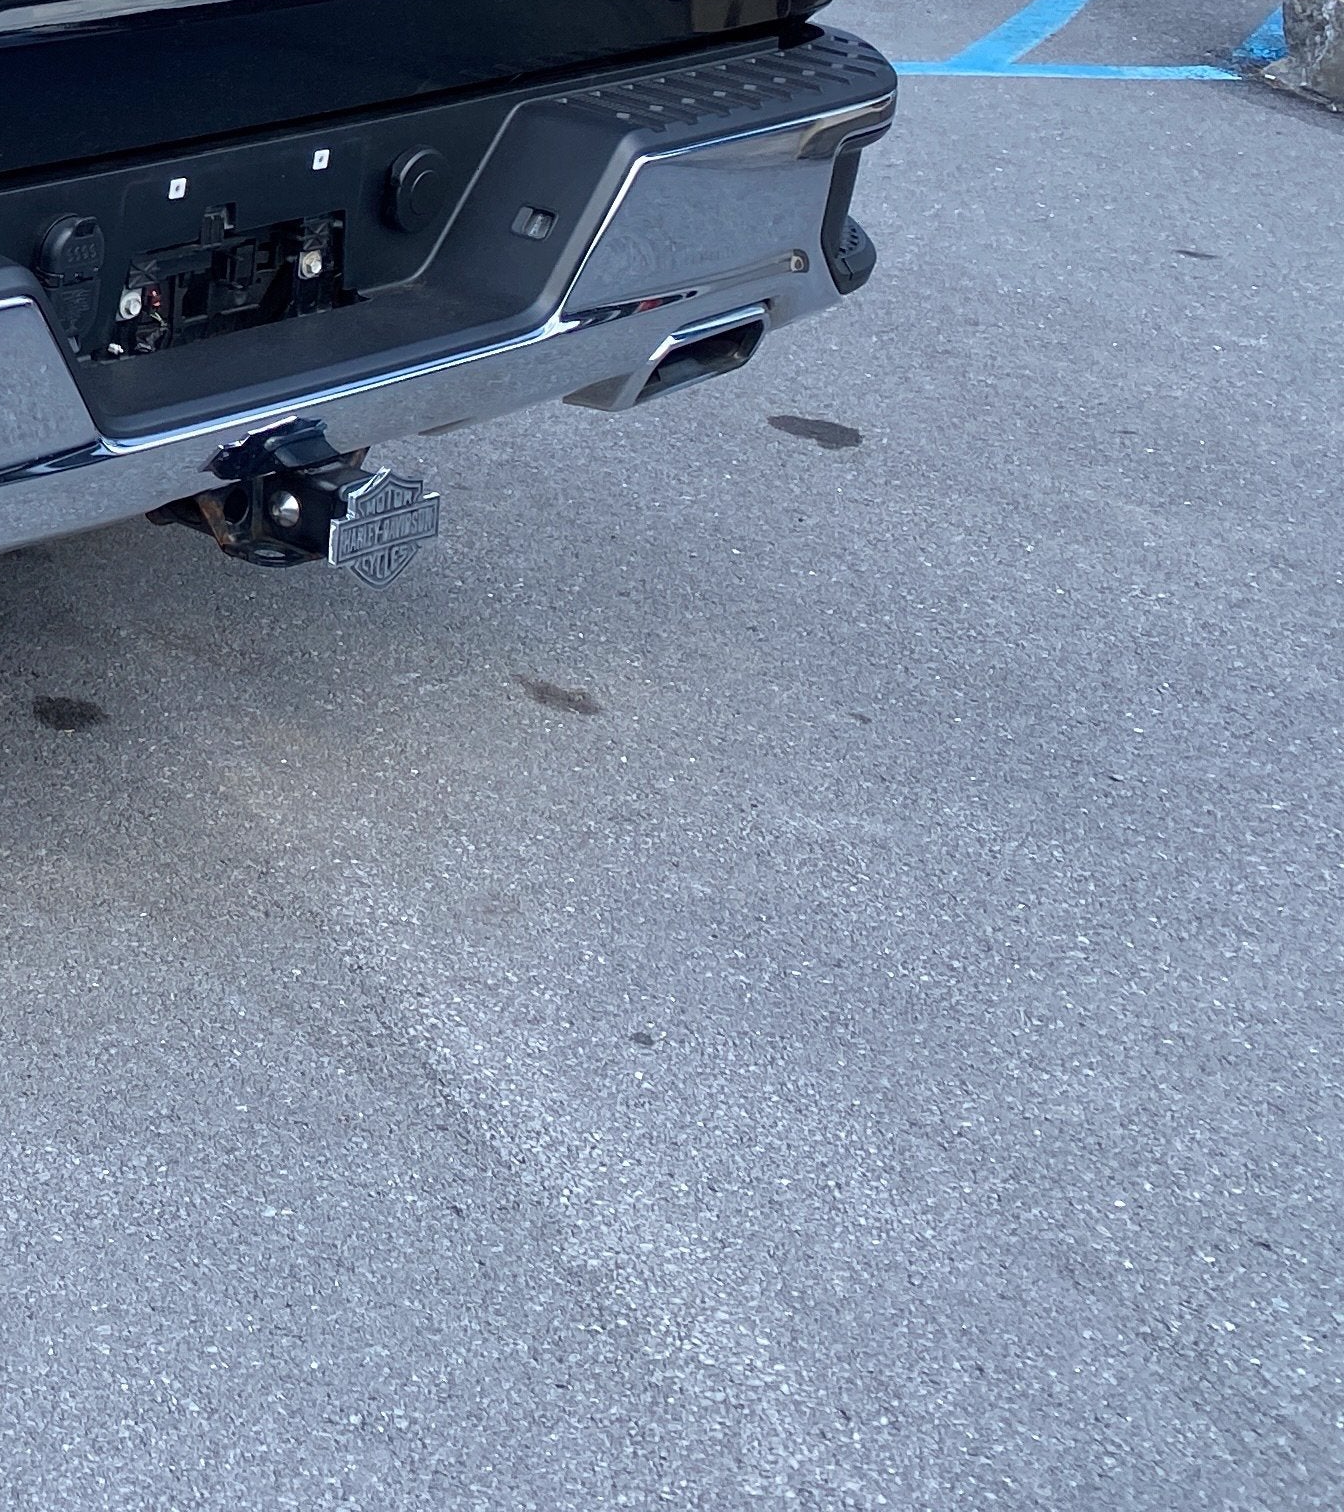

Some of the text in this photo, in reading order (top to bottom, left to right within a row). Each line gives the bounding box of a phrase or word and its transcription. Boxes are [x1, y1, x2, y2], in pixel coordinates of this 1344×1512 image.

[364, 489, 414, 516] MOTOR
[341, 506, 434, 556] HARLEY-DAVIDSON
[361, 542, 409, 579] CYCLES
